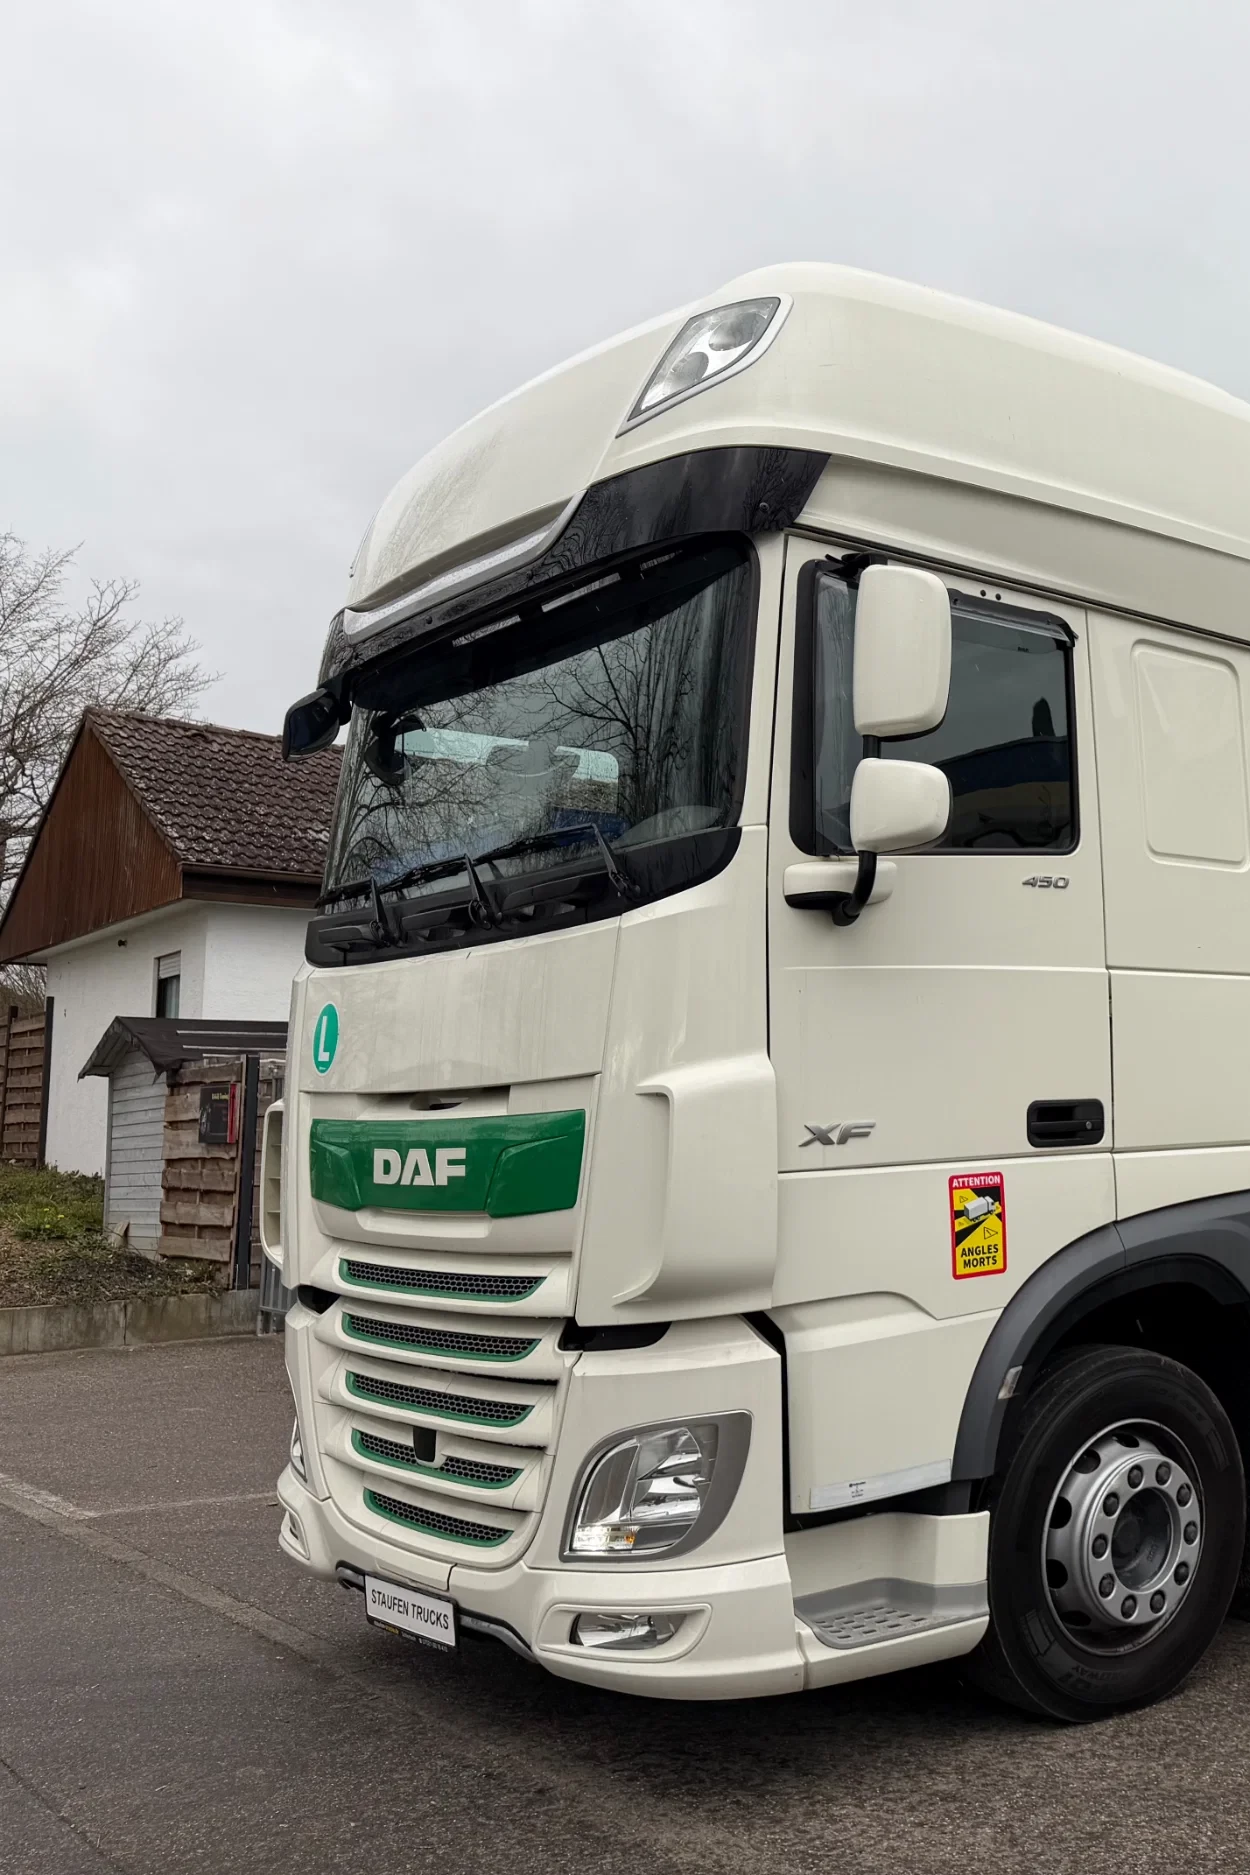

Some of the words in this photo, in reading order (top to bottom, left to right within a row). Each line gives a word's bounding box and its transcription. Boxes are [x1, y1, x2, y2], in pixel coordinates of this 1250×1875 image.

[1021, 875, 1070, 889] 450
[317, 1015, 330, 1062] L
[798, 1120, 876, 1148] XF
[373, 1147, 466, 1186] DAF
[952, 1174, 1001, 1188] ATTENTION
[960, 1243, 999, 1258] ANGLES
[963, 1255, 998, 1269] MORTS
[371, 1588, 409, 1616] STAUFEN
[411, 1602, 449, 1630] TRUCKS
